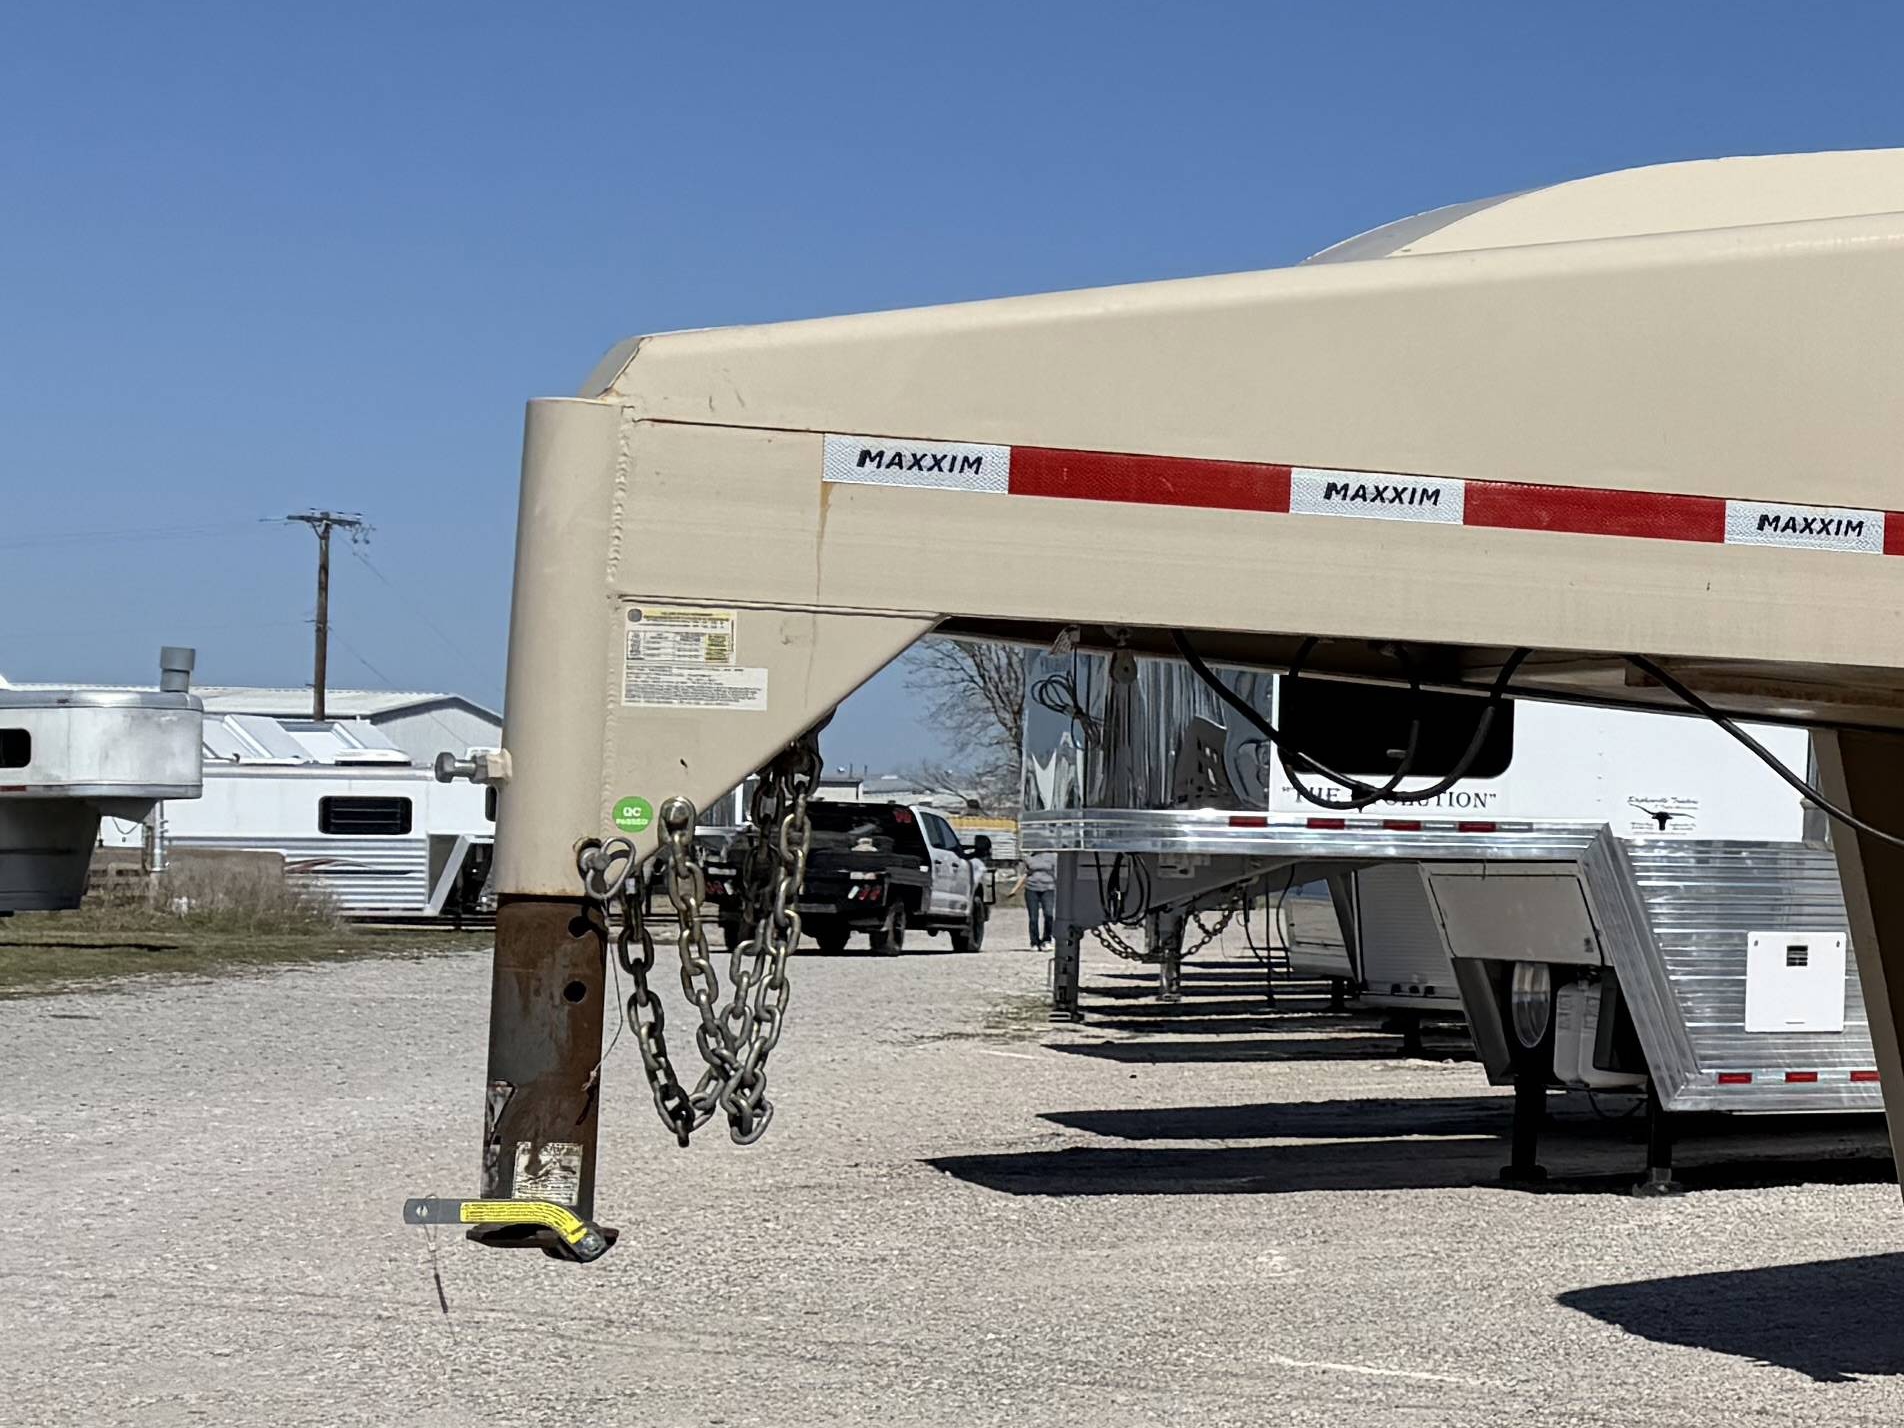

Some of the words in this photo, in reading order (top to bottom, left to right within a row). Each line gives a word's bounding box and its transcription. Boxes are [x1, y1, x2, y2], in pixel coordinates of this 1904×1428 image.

[857, 448, 983, 476] MAXXIM
[1323, 481, 1440, 507] MAXXIM
[1757, 513, 1864, 538] MAXXIM
[623, 806, 642, 817] QC
